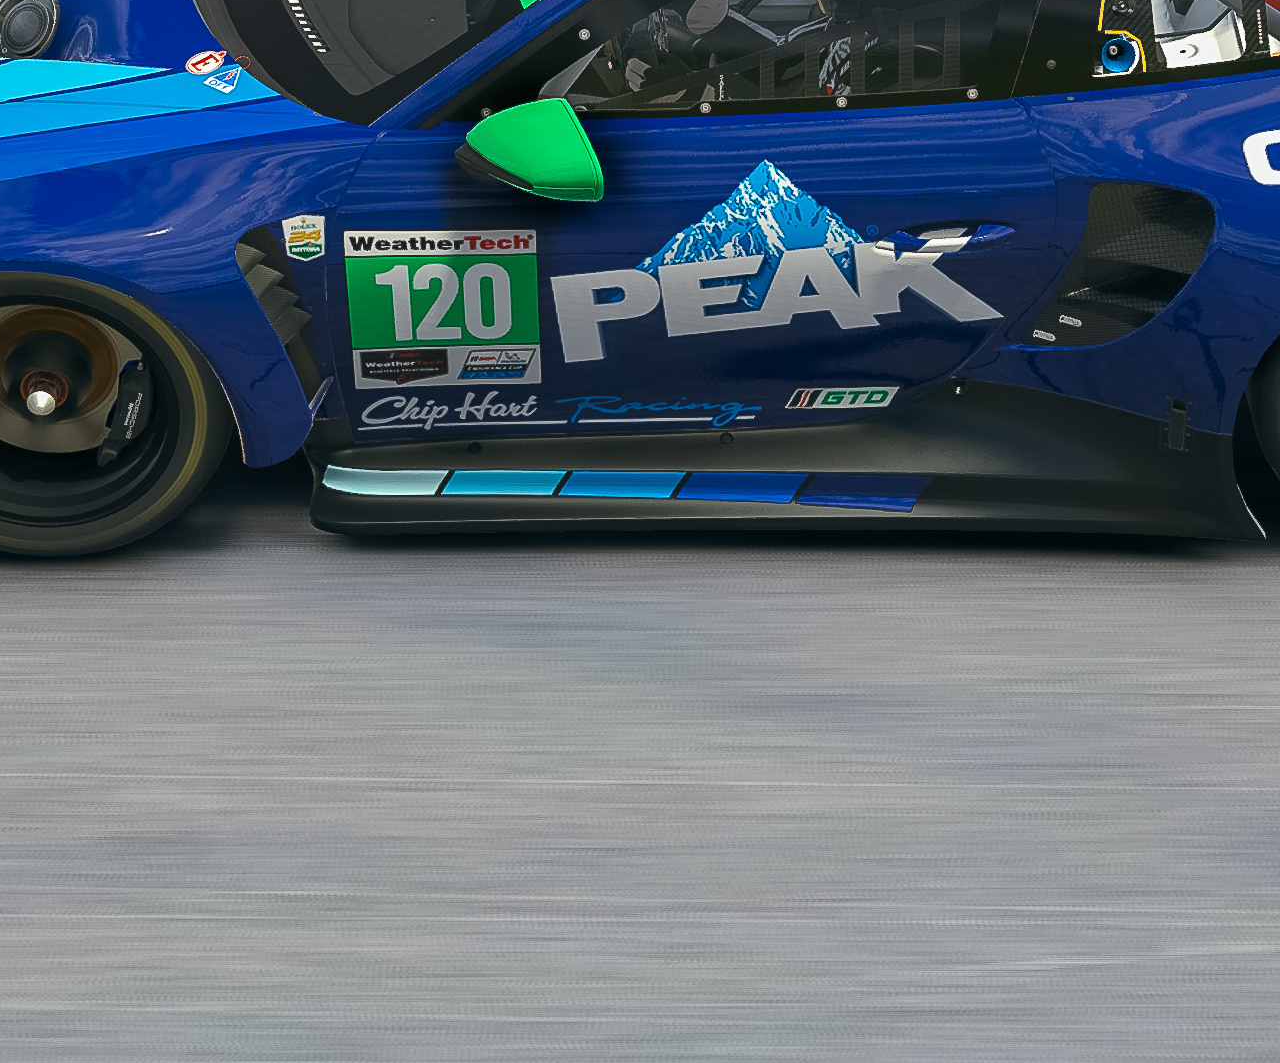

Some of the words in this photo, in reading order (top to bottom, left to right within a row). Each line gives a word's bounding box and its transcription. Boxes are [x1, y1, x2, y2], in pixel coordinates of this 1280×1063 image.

[349, 234, 531, 252] WeatherTech
[375, 262, 513, 342] 120
[550, 242, 1005, 364] PEAK
[361, 395, 449, 430] Chip
[454, 390, 538, 421] Hart
[555, 396, 762, 426] Racing
[820, 389, 889, 406] GTD
